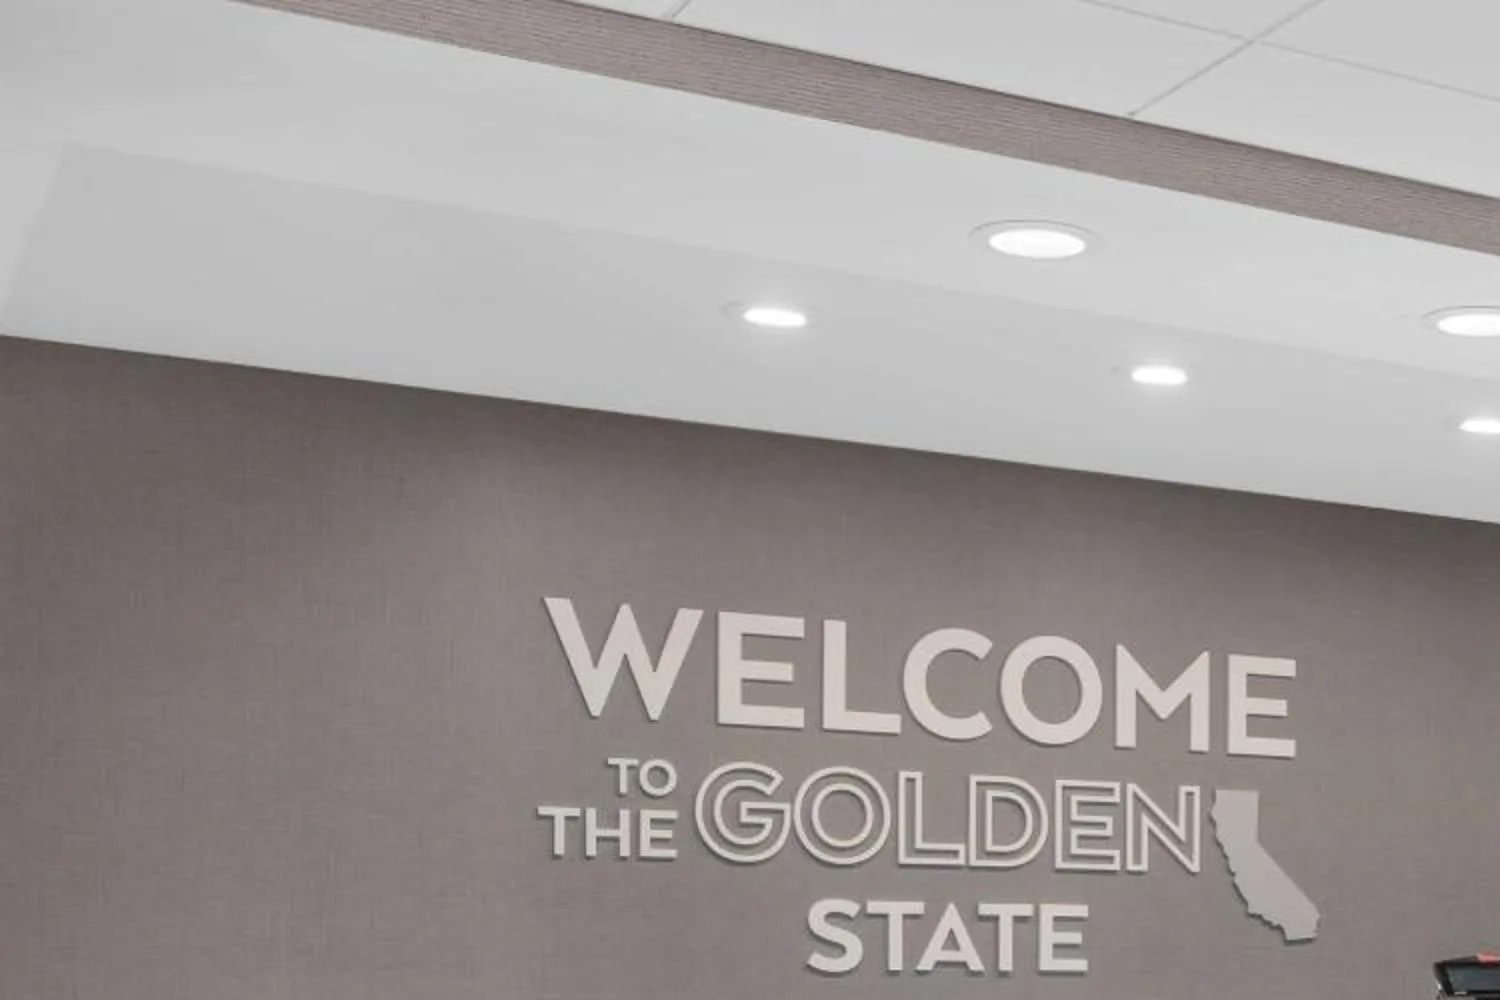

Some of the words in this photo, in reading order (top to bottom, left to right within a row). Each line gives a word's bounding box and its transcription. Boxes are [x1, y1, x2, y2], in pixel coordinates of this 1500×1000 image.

[543, 597, 1298, 758] WELCOME
[537, 805, 680, 859] THE
[694, 760, 1201, 874] GOLDEN
[607, 756, 678, 797] TO
[806, 897, 1090, 974] STATE
